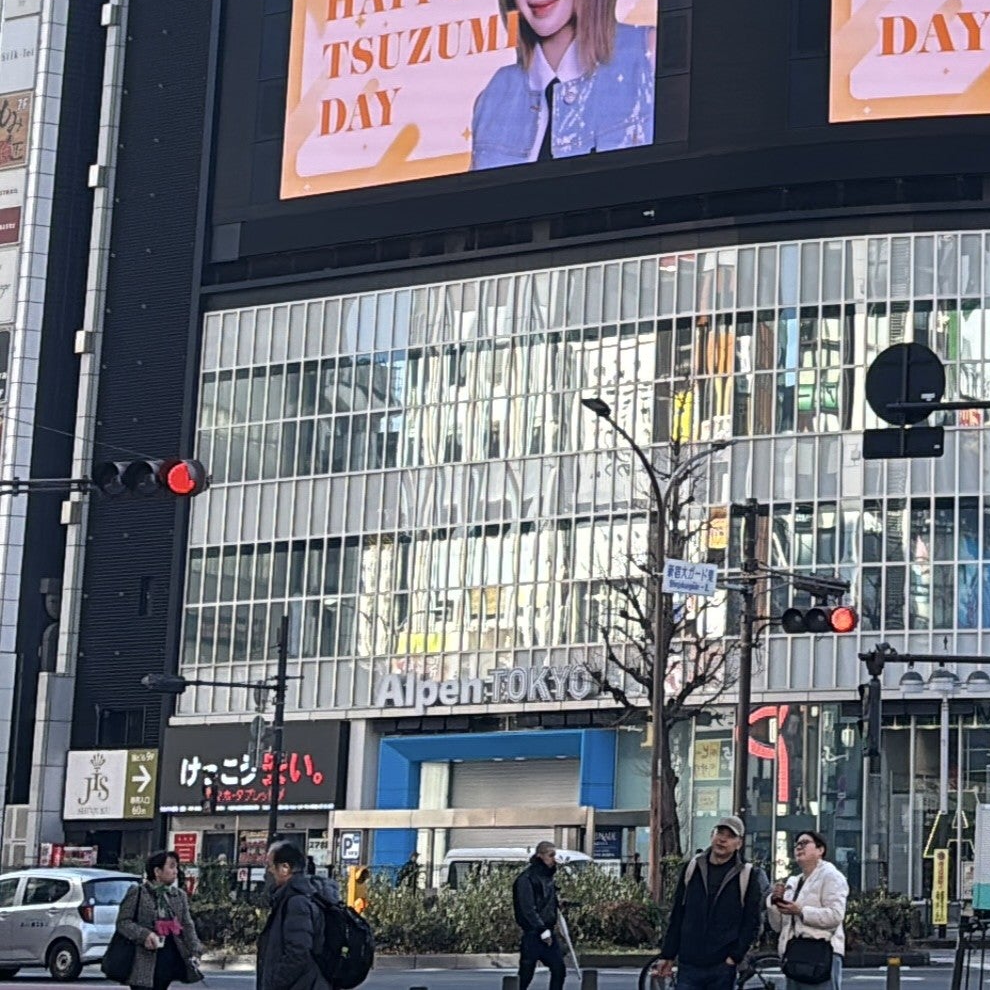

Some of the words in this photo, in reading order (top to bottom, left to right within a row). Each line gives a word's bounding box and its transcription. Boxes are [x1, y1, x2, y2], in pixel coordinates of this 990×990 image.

[322, 11, 519, 80] TSUZUMI
[318, 87, 401, 138] DAY
[374, 670, 483, 716] Alpen
[489, 665, 593, 702] TOKYO
